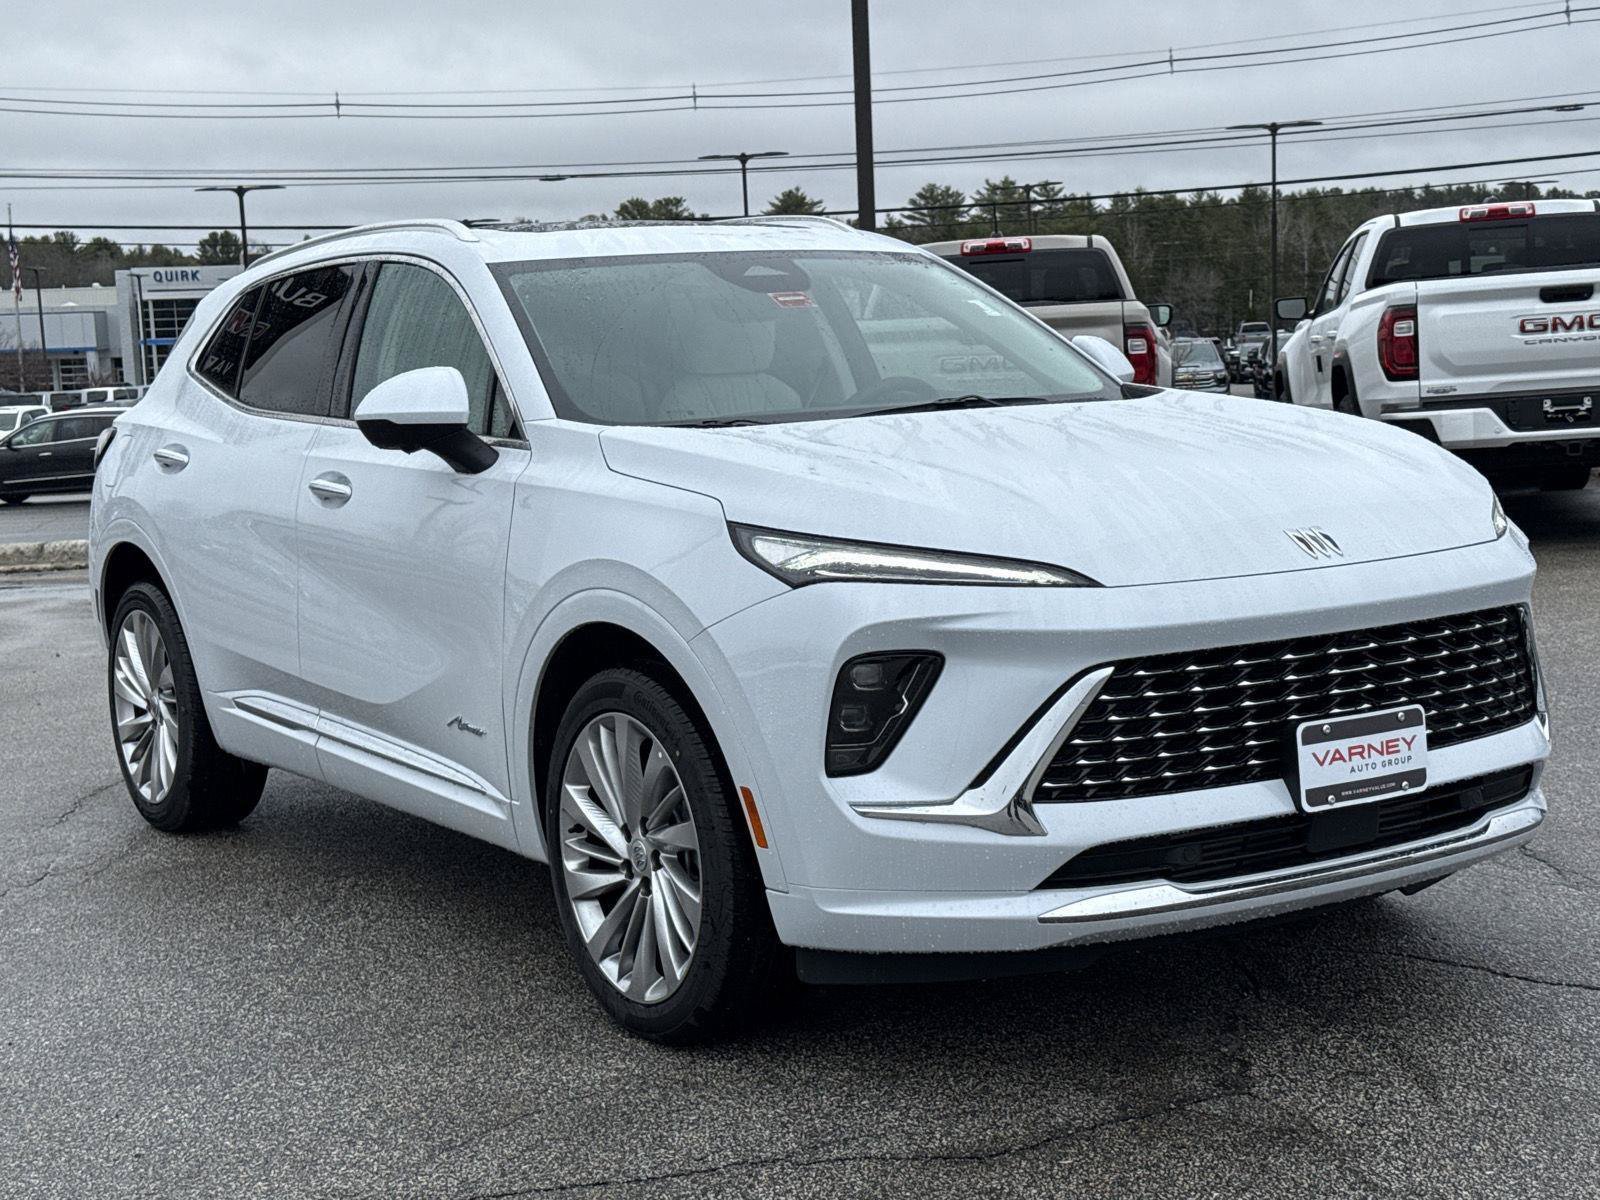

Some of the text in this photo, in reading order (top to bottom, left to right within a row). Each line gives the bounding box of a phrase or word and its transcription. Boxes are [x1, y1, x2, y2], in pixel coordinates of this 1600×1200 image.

[153, 270, 200, 283] QUIRK
[1524, 336, 1600, 345] CANYO
[1312, 735, 1417, 767] VARNEY
[1349, 755, 1413, 774] AUTO GROUP
